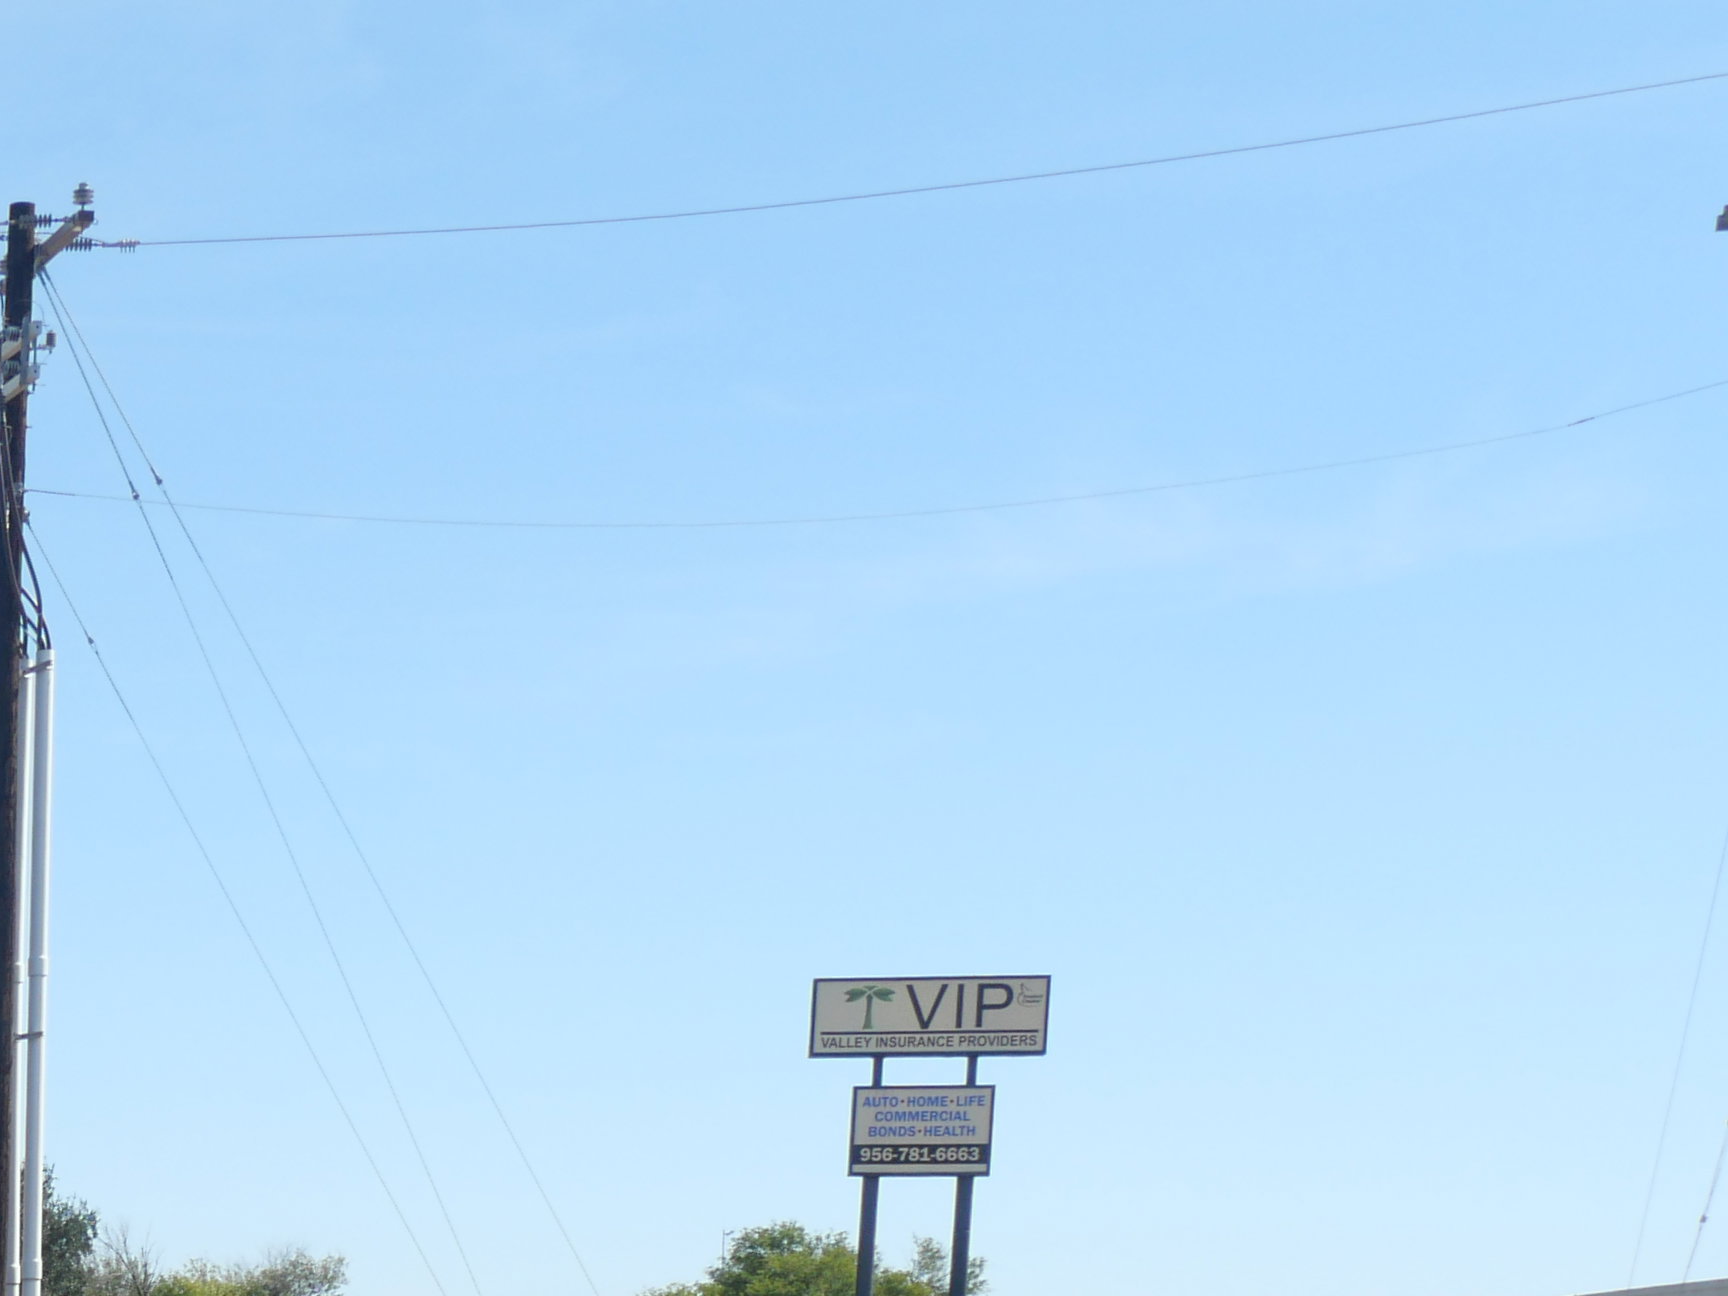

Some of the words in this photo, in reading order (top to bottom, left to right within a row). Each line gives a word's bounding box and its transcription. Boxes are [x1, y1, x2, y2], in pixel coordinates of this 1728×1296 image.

[906, 983, 1014, 1029] VIP
[821, 1036, 872, 1049] VALLEY
[875, 1035, 954, 1048] INSURANCE
[959, 1034, 1038, 1047] PROVIDERS
[862, 1096, 899, 1107] AUTO
[907, 1096, 948, 1107] HOME
[956, 1095, 986, 1107] LIFE
[874, 1111, 971, 1122] COMMERCIAL
[868, 1126, 916, 1137] BONDS
[923, 1125, 976, 1137] HEALTH
[860, 1146, 980, 1162] 956-781-6663
